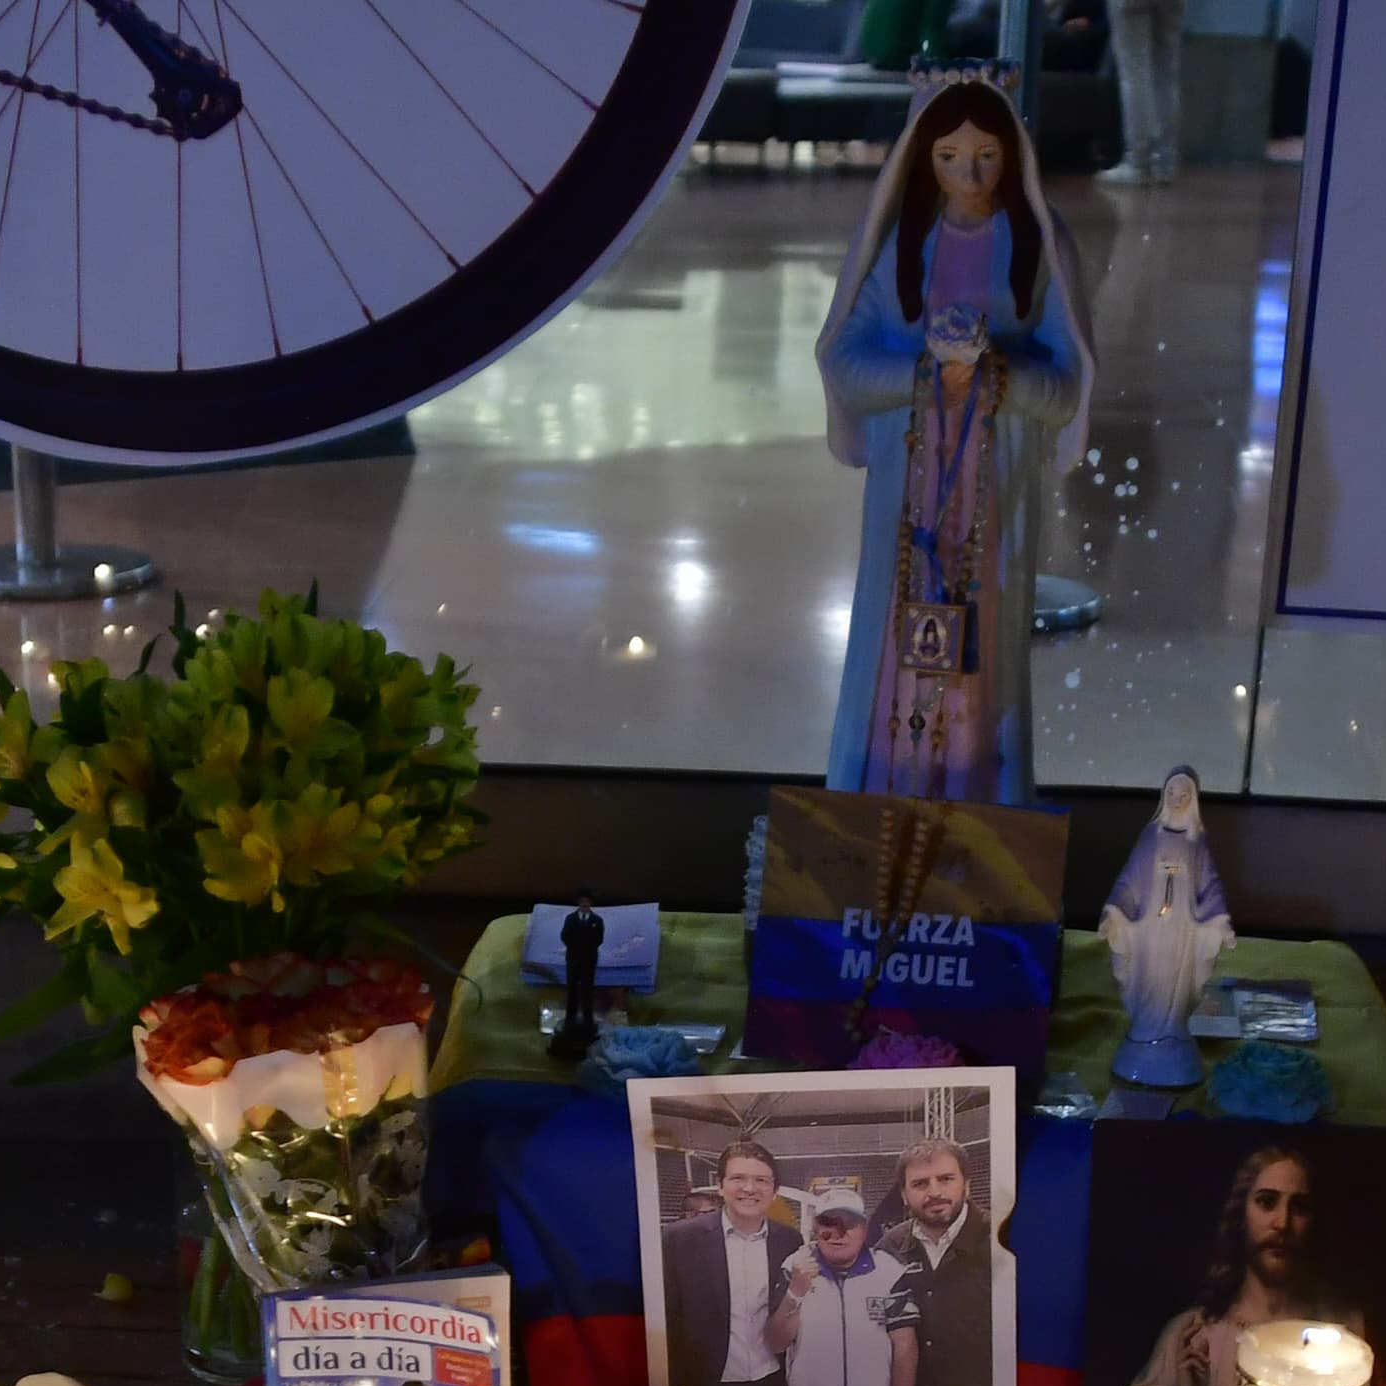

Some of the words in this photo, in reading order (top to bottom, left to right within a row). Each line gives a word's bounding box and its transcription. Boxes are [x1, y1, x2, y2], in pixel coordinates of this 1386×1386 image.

[842, 907, 976, 947] FURZA
[839, 949, 975, 988] MGUEL
[288, 1305, 482, 1345] Misericordia
[292, 1345, 339, 1371] día
[350, 1351, 366, 1370] a
[376, 1346, 421, 1374] día
